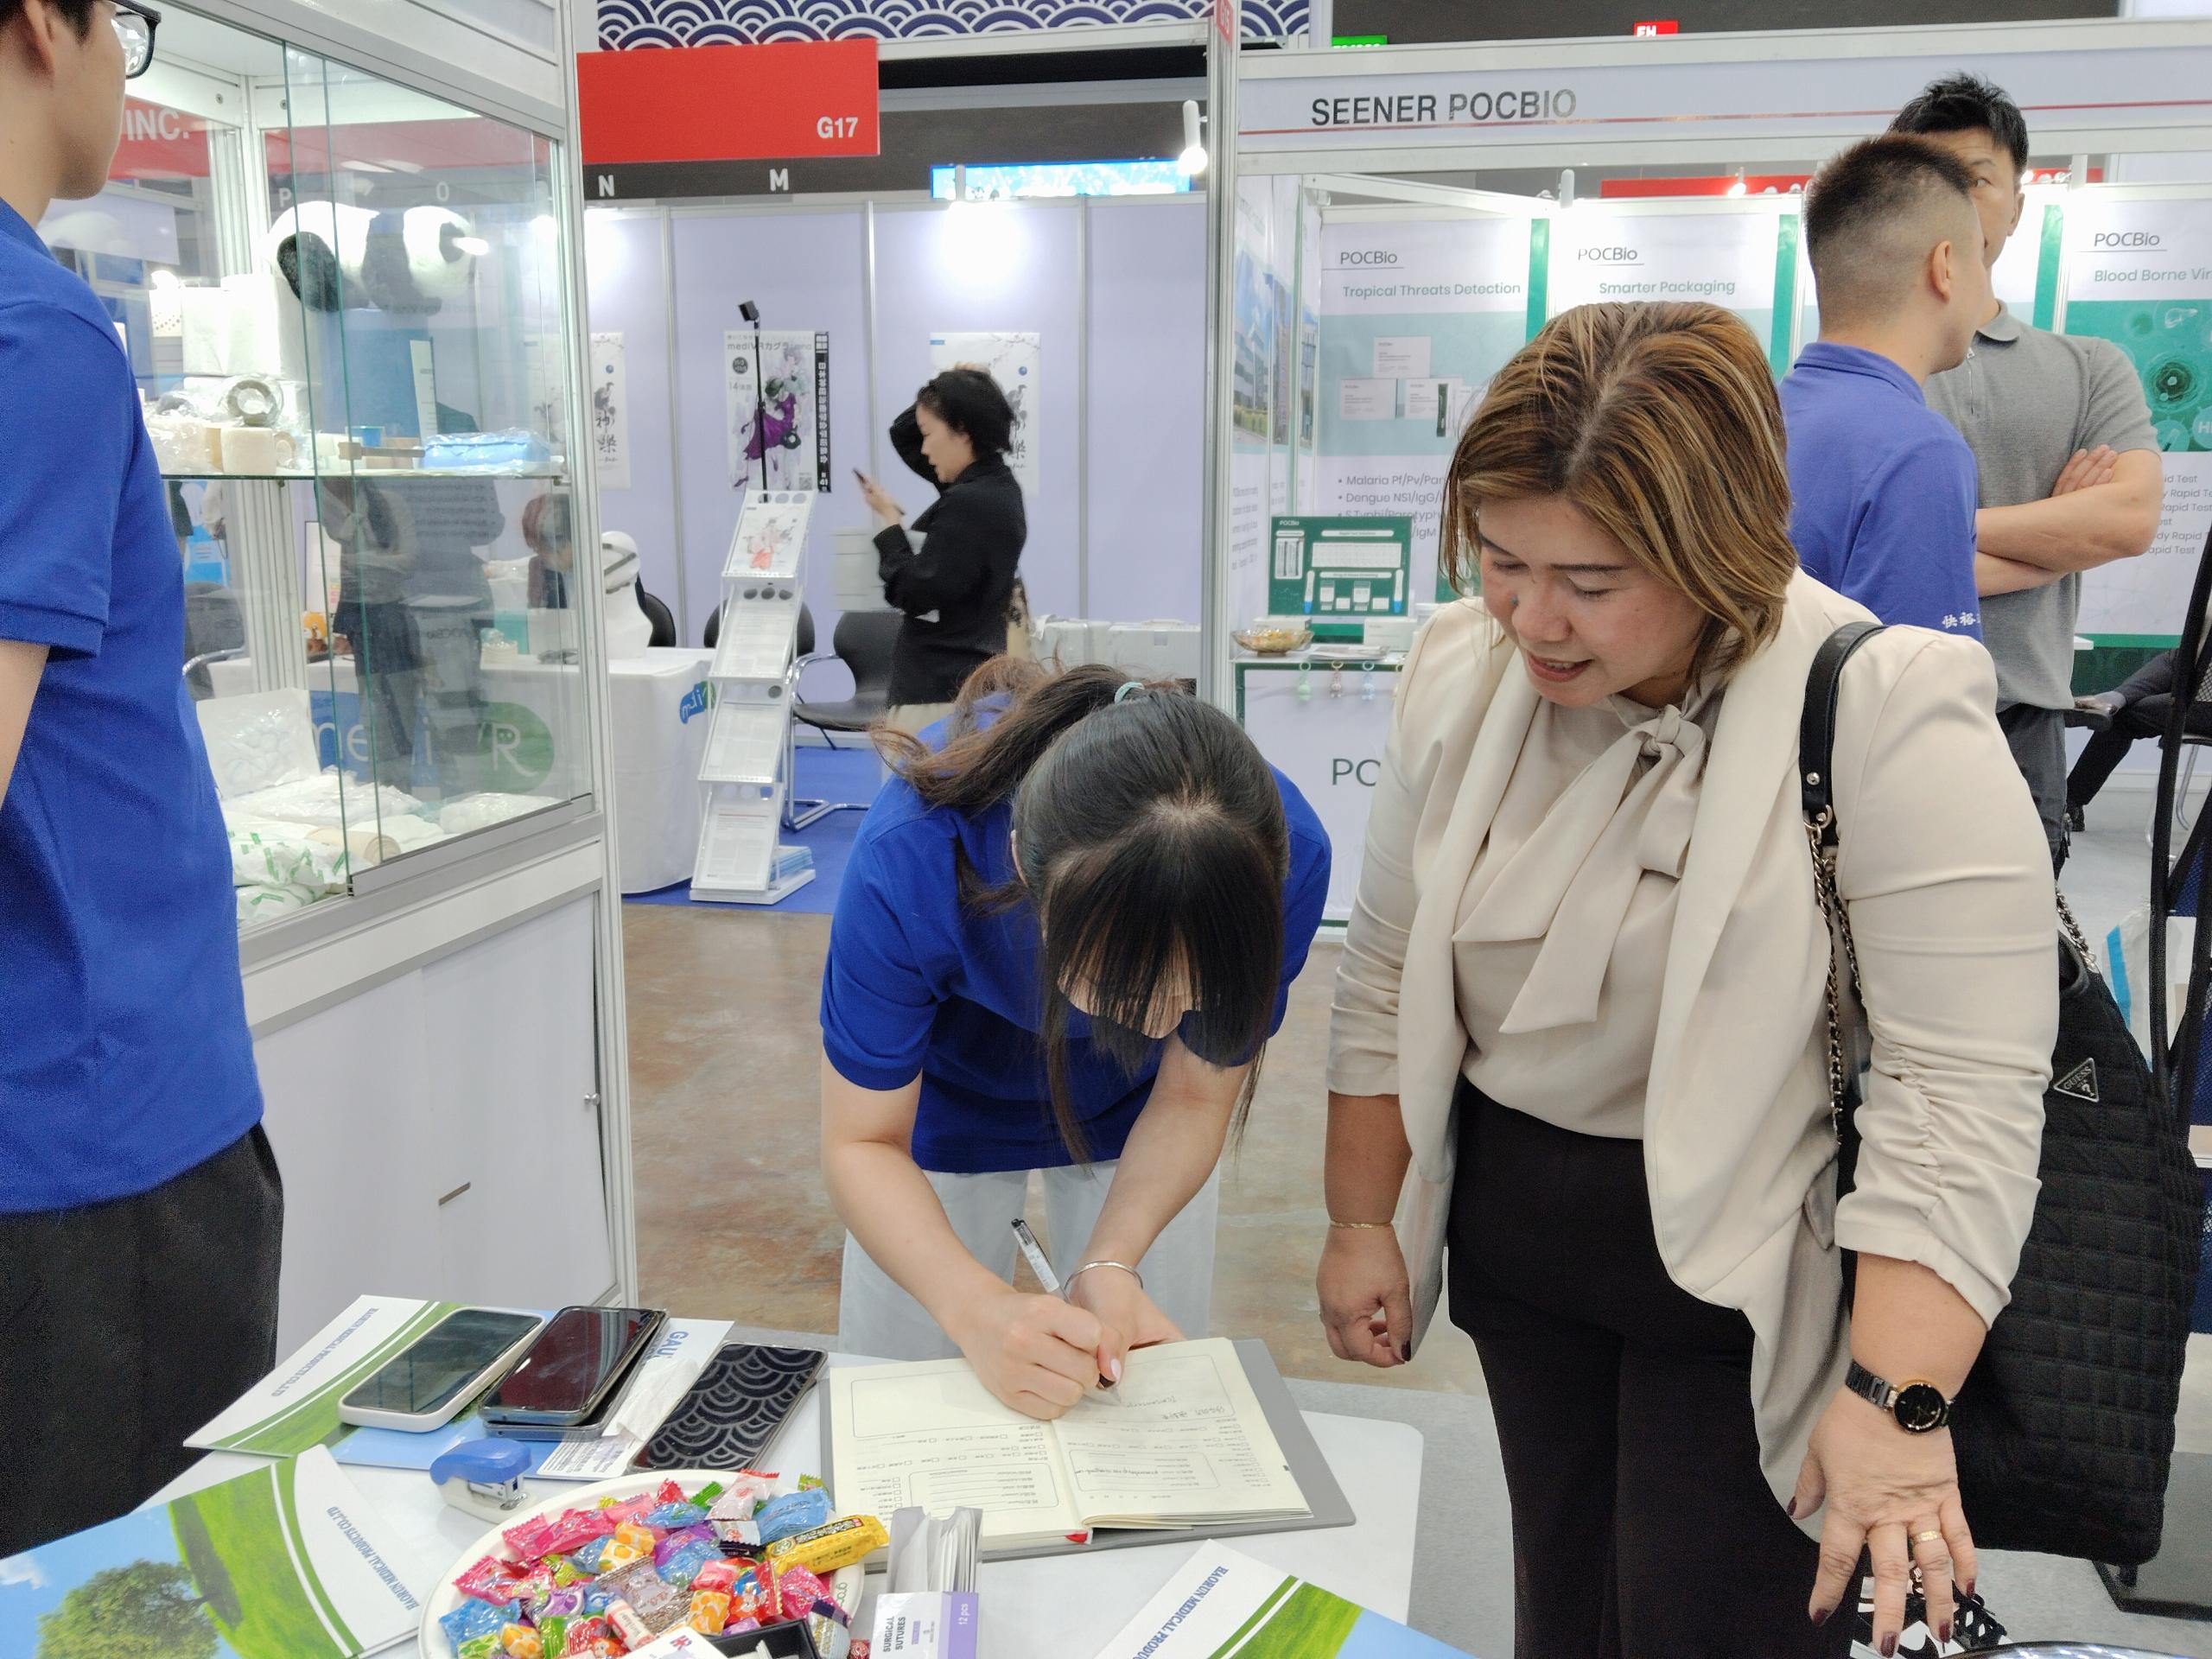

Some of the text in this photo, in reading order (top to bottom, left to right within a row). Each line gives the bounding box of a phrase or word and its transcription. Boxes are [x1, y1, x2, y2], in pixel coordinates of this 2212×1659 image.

[1312, 89, 1577, 126] SEENER POCBIO
[125, 107, 189, 142] INC.
[817, 117, 858, 138] G17
[598, 175, 615, 197] N
[769, 168, 789, 191] M
[278, 188, 292, 207] P
[2094, 232, 2160, 247] POCBio
[1339, 251, 1398, 264] POCBio
[1578, 247, 1638, 261] POCBio
[2094, 270, 2138, 282] Blood
[2142, 270, 2187, 282] Borne
[1343, 283, 1521, 300] Tropical Threats Detection
[1599, 280, 1736, 296] Smarter Packaging
[1346, 476, 1389, 485] Malaria
[2177, 474, 2198, 483] Test
[1346, 493, 1390, 505] Dengue
[2171, 489, 2200, 499] Rapid
[1413, 525, 1436, 539] /IgM
[2157, 531, 2202, 542] dy Rapid
[2148, 546, 2171, 556] apid
[2063, 1066, 2092, 1090] GUESS
[654, 1331, 690, 1359] GAU
[368, 1555, 398, 1586] MEDICAL
[1193, 1566, 1229, 1599] HAORUN
[957, 1603, 969, 1625] 12 pcs
[1160, 1596, 1201, 1631] MEDICAL
[883, 1616, 895, 1652] SURGICAL
[895, 1616, 906, 1650] SUTURES
